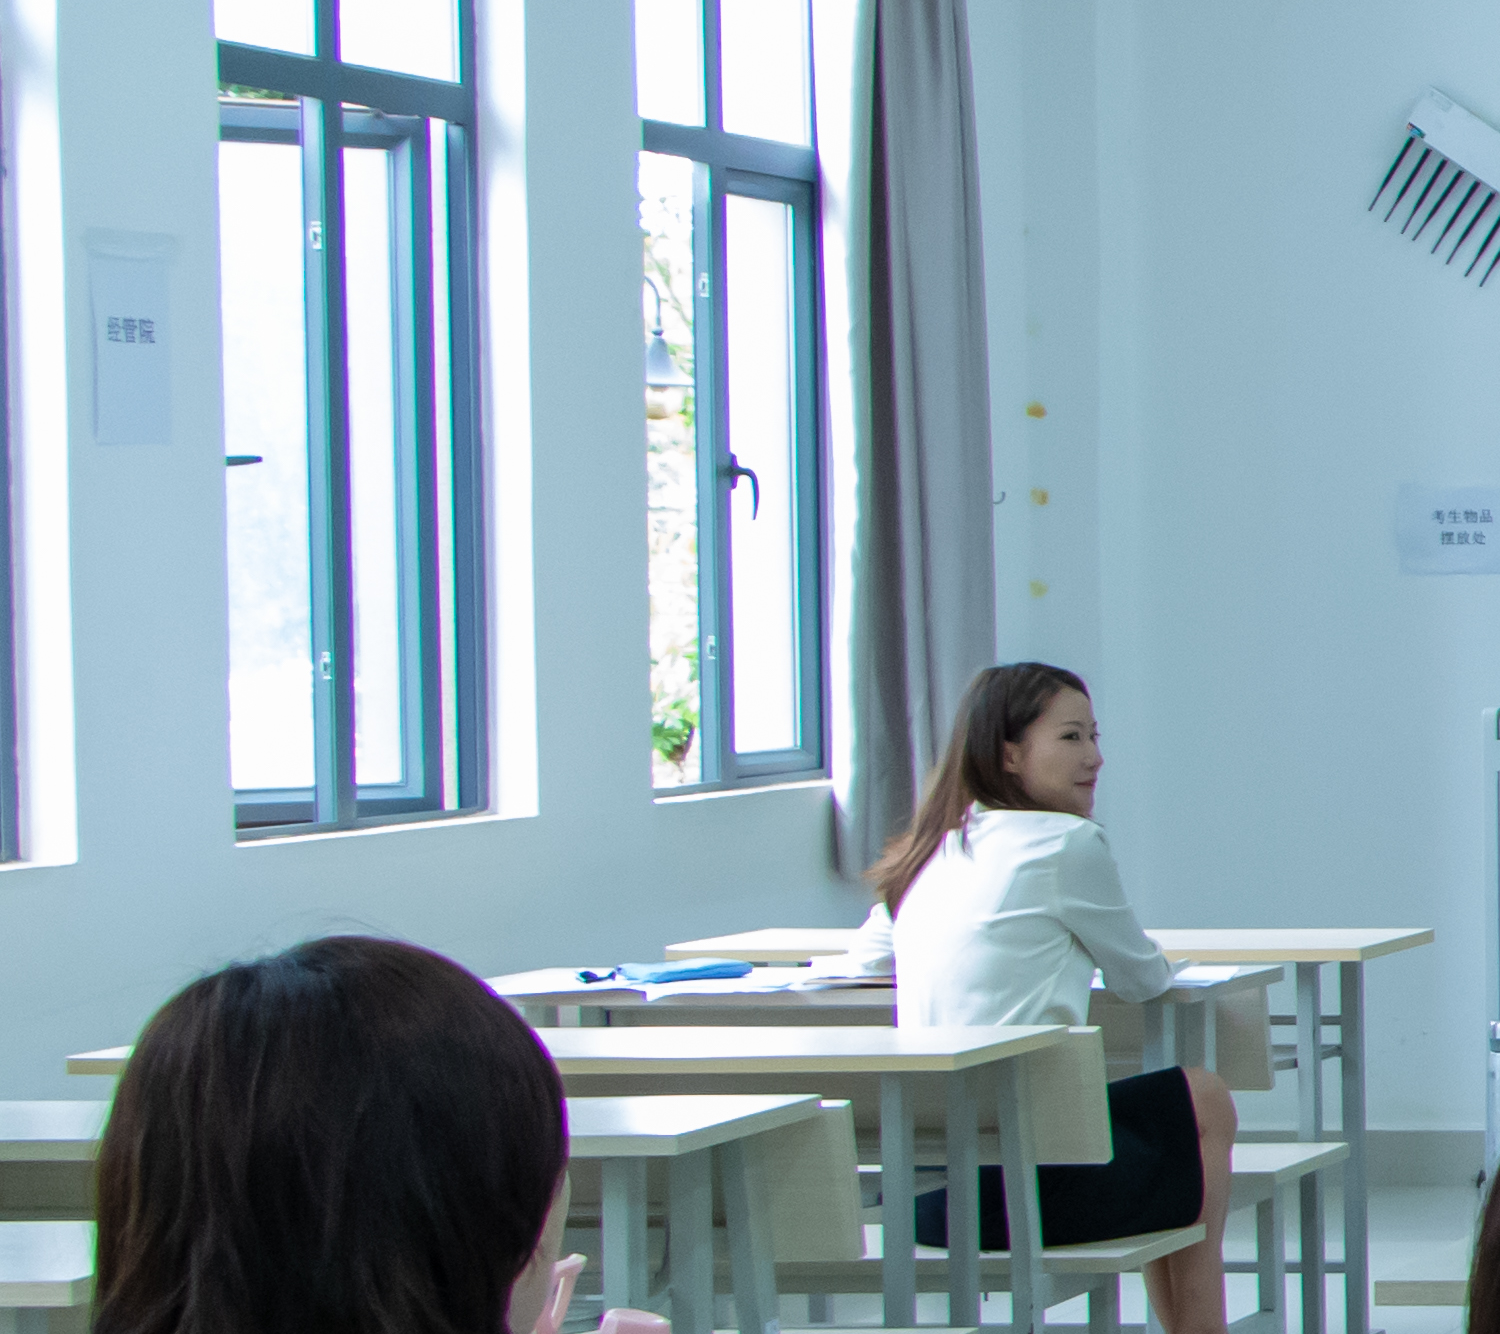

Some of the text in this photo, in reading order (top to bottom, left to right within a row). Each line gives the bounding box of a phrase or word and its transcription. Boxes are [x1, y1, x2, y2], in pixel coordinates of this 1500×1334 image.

[107, 316, 156, 344] 经管院
[1432, 509, 1493, 524] 考生物品
[1441, 531, 1486, 545] 摆放处
